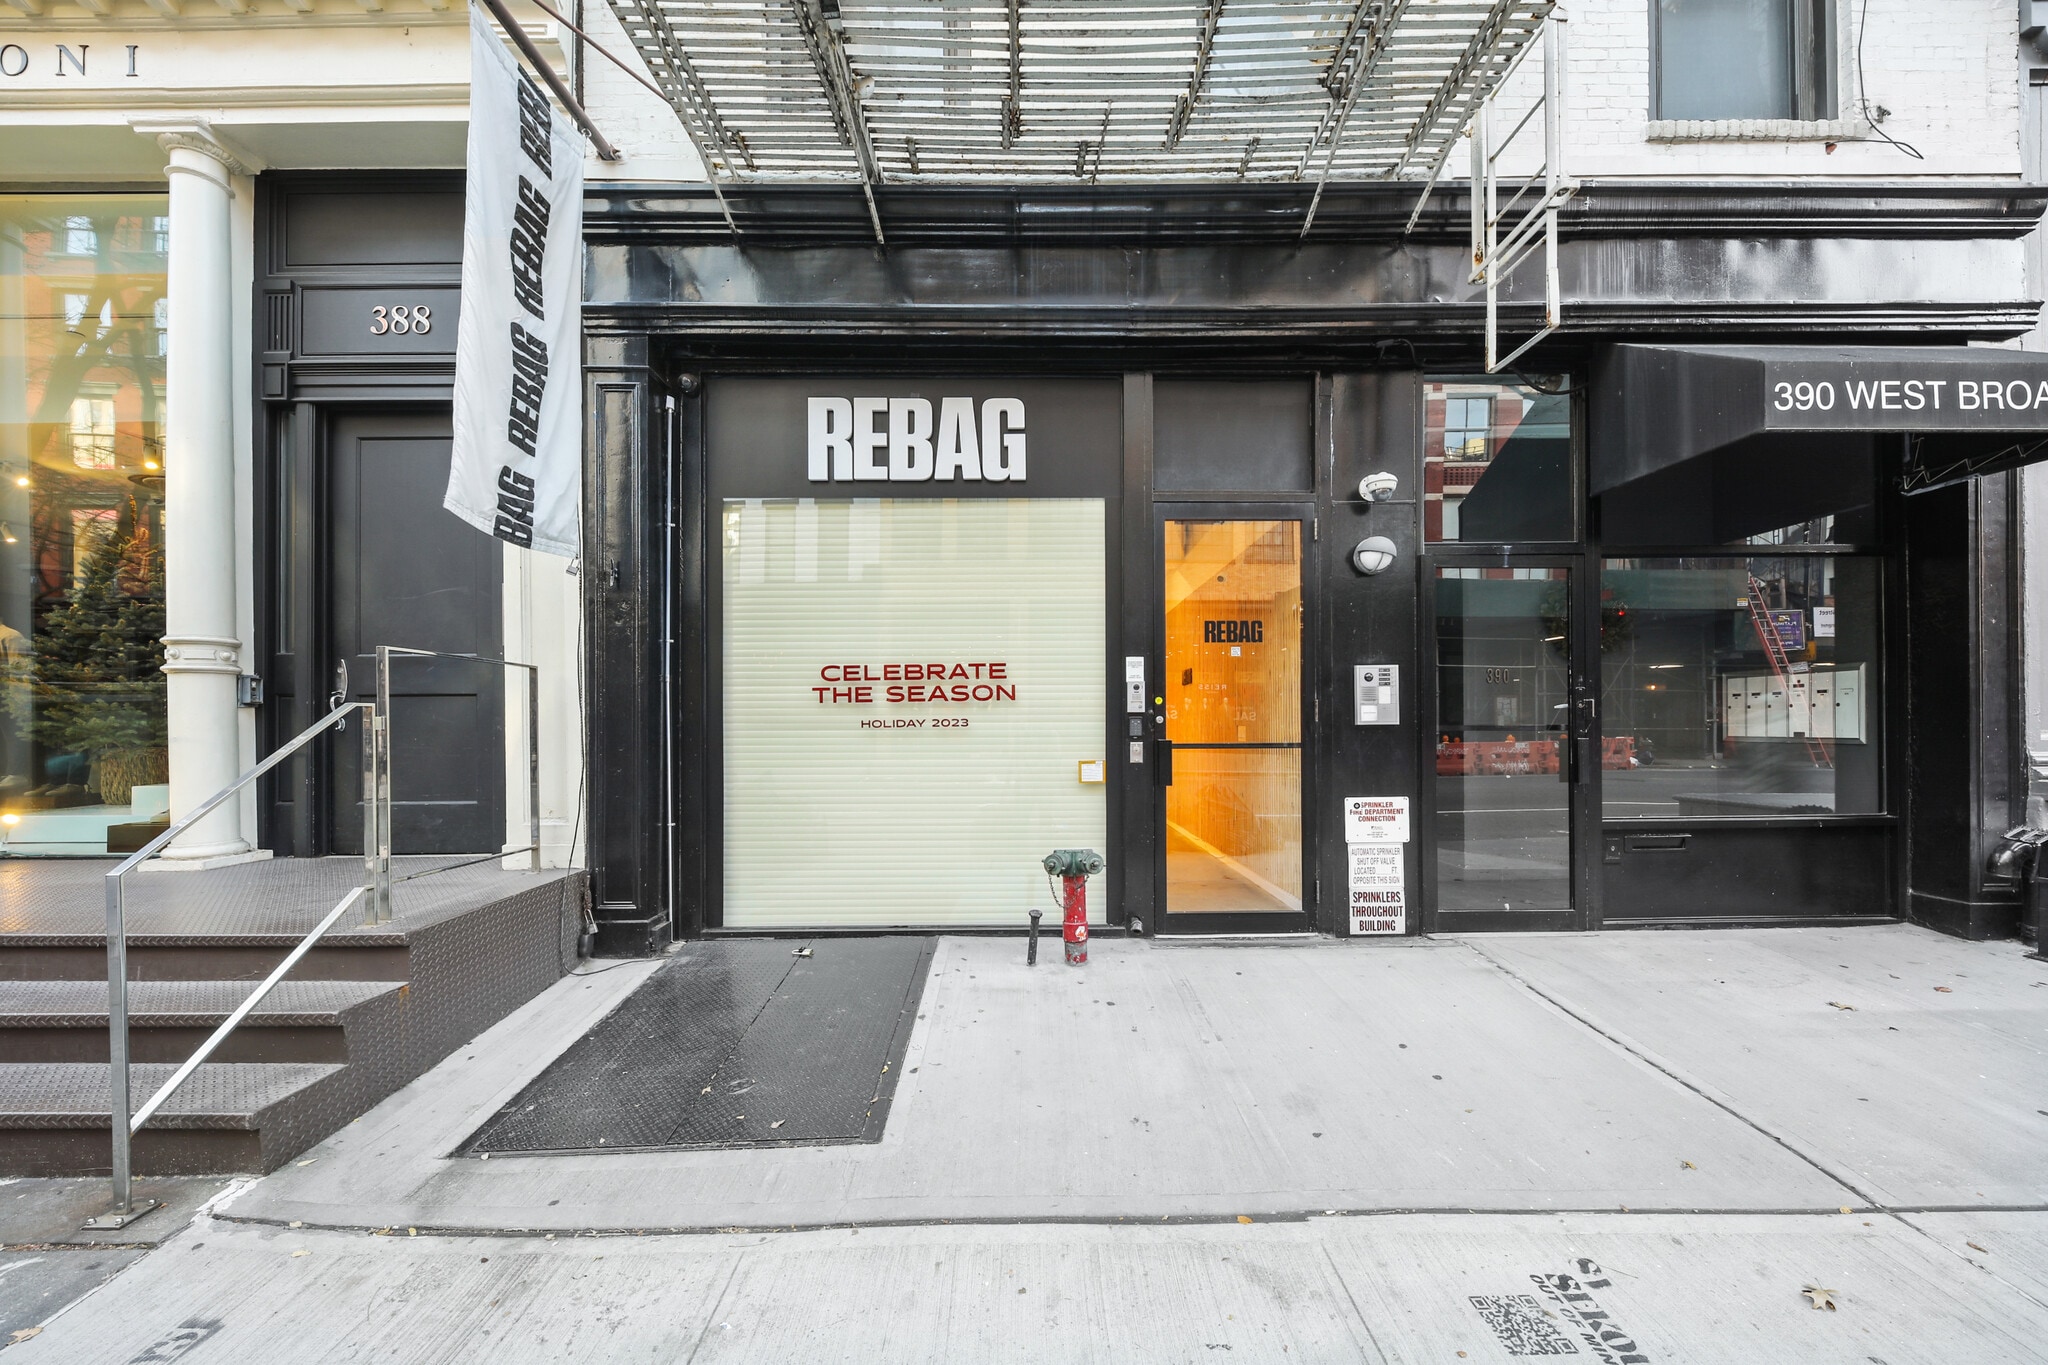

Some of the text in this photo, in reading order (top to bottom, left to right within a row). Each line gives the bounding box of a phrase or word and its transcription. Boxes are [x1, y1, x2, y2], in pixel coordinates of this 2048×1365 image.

[0, 44, 139, 77] ONI
[510, 174, 551, 321] REBAG
[370, 305, 431, 335] 388
[508, 322, 548, 457] REBAG
[1774, 381, 1835, 411] 390
[1845, 380, 1947, 410] WEST
[807, 397, 1027, 482] REBAG
[493, 465, 535, 549] BAG
[1204, 621, 1263, 643] REBAG
[820, 663, 1008, 682] CELEBRATE
[1486, 668, 1510, 684] 390
[812, 684, 1016, 703] THE SEASON
[861, 718, 969, 729] HOLIDAY 2023
[1351, 848, 1376, 856] AUTOMATIC
[1380, 857, 1395, 865] VALVE
[1353, 876, 1376, 884] OPPOSITE
[1377, 876, 1387, 884] THIS
[1354, 867, 1376, 875] LOCATED
[1353, 892, 1401, 903] SPRINKLERS
[1351, 906, 1403, 917] THROUGHOUT
[1359, 920, 1396, 931] BUILDING
[1529, 1274, 1564, 1304] OUT
[1559, 1308, 1587, 1329] OF
